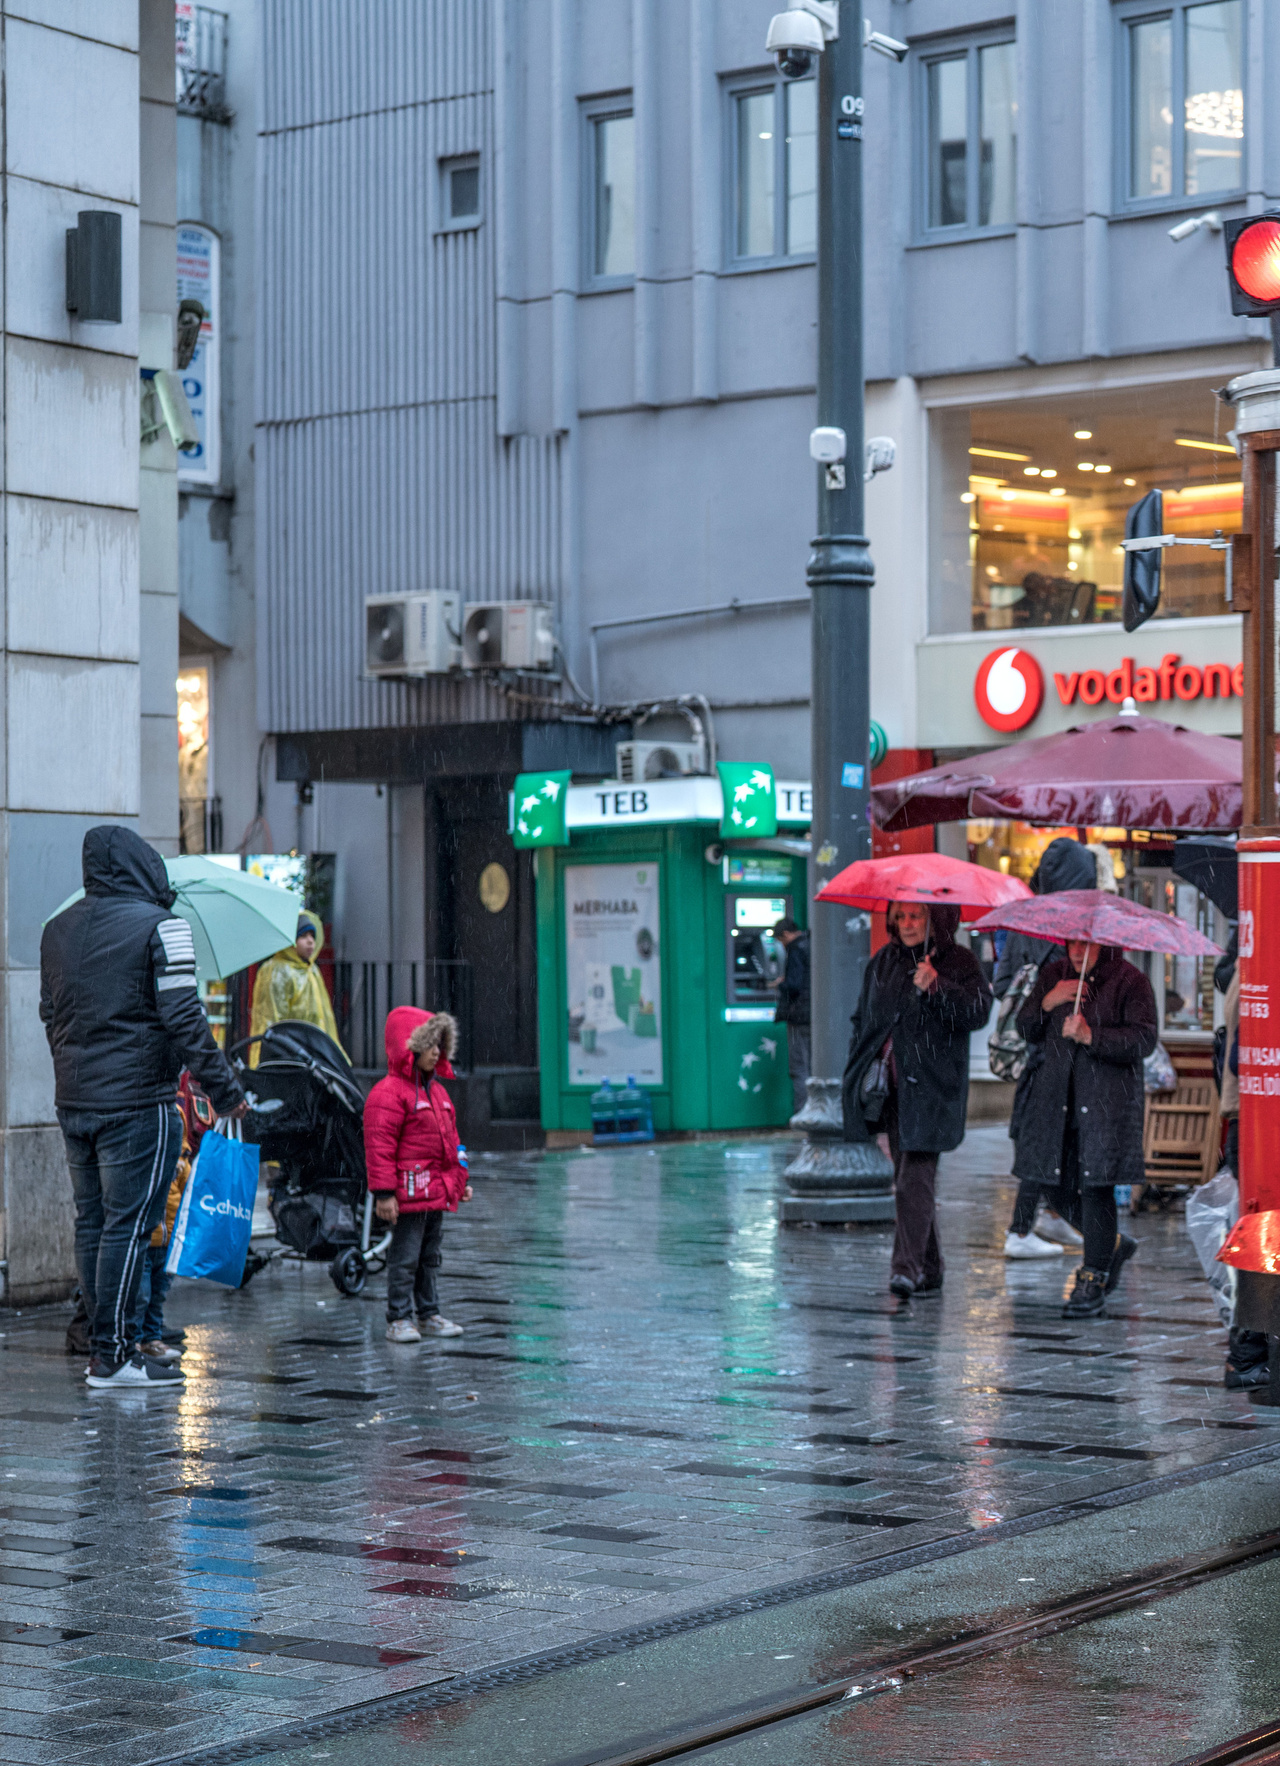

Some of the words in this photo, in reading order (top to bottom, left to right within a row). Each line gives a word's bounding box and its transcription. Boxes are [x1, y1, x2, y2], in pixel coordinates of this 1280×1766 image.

[841, 95, 864, 116] 09
[595, 790, 648, 815] TEB
[573, 899, 638, 915] MERHABA
